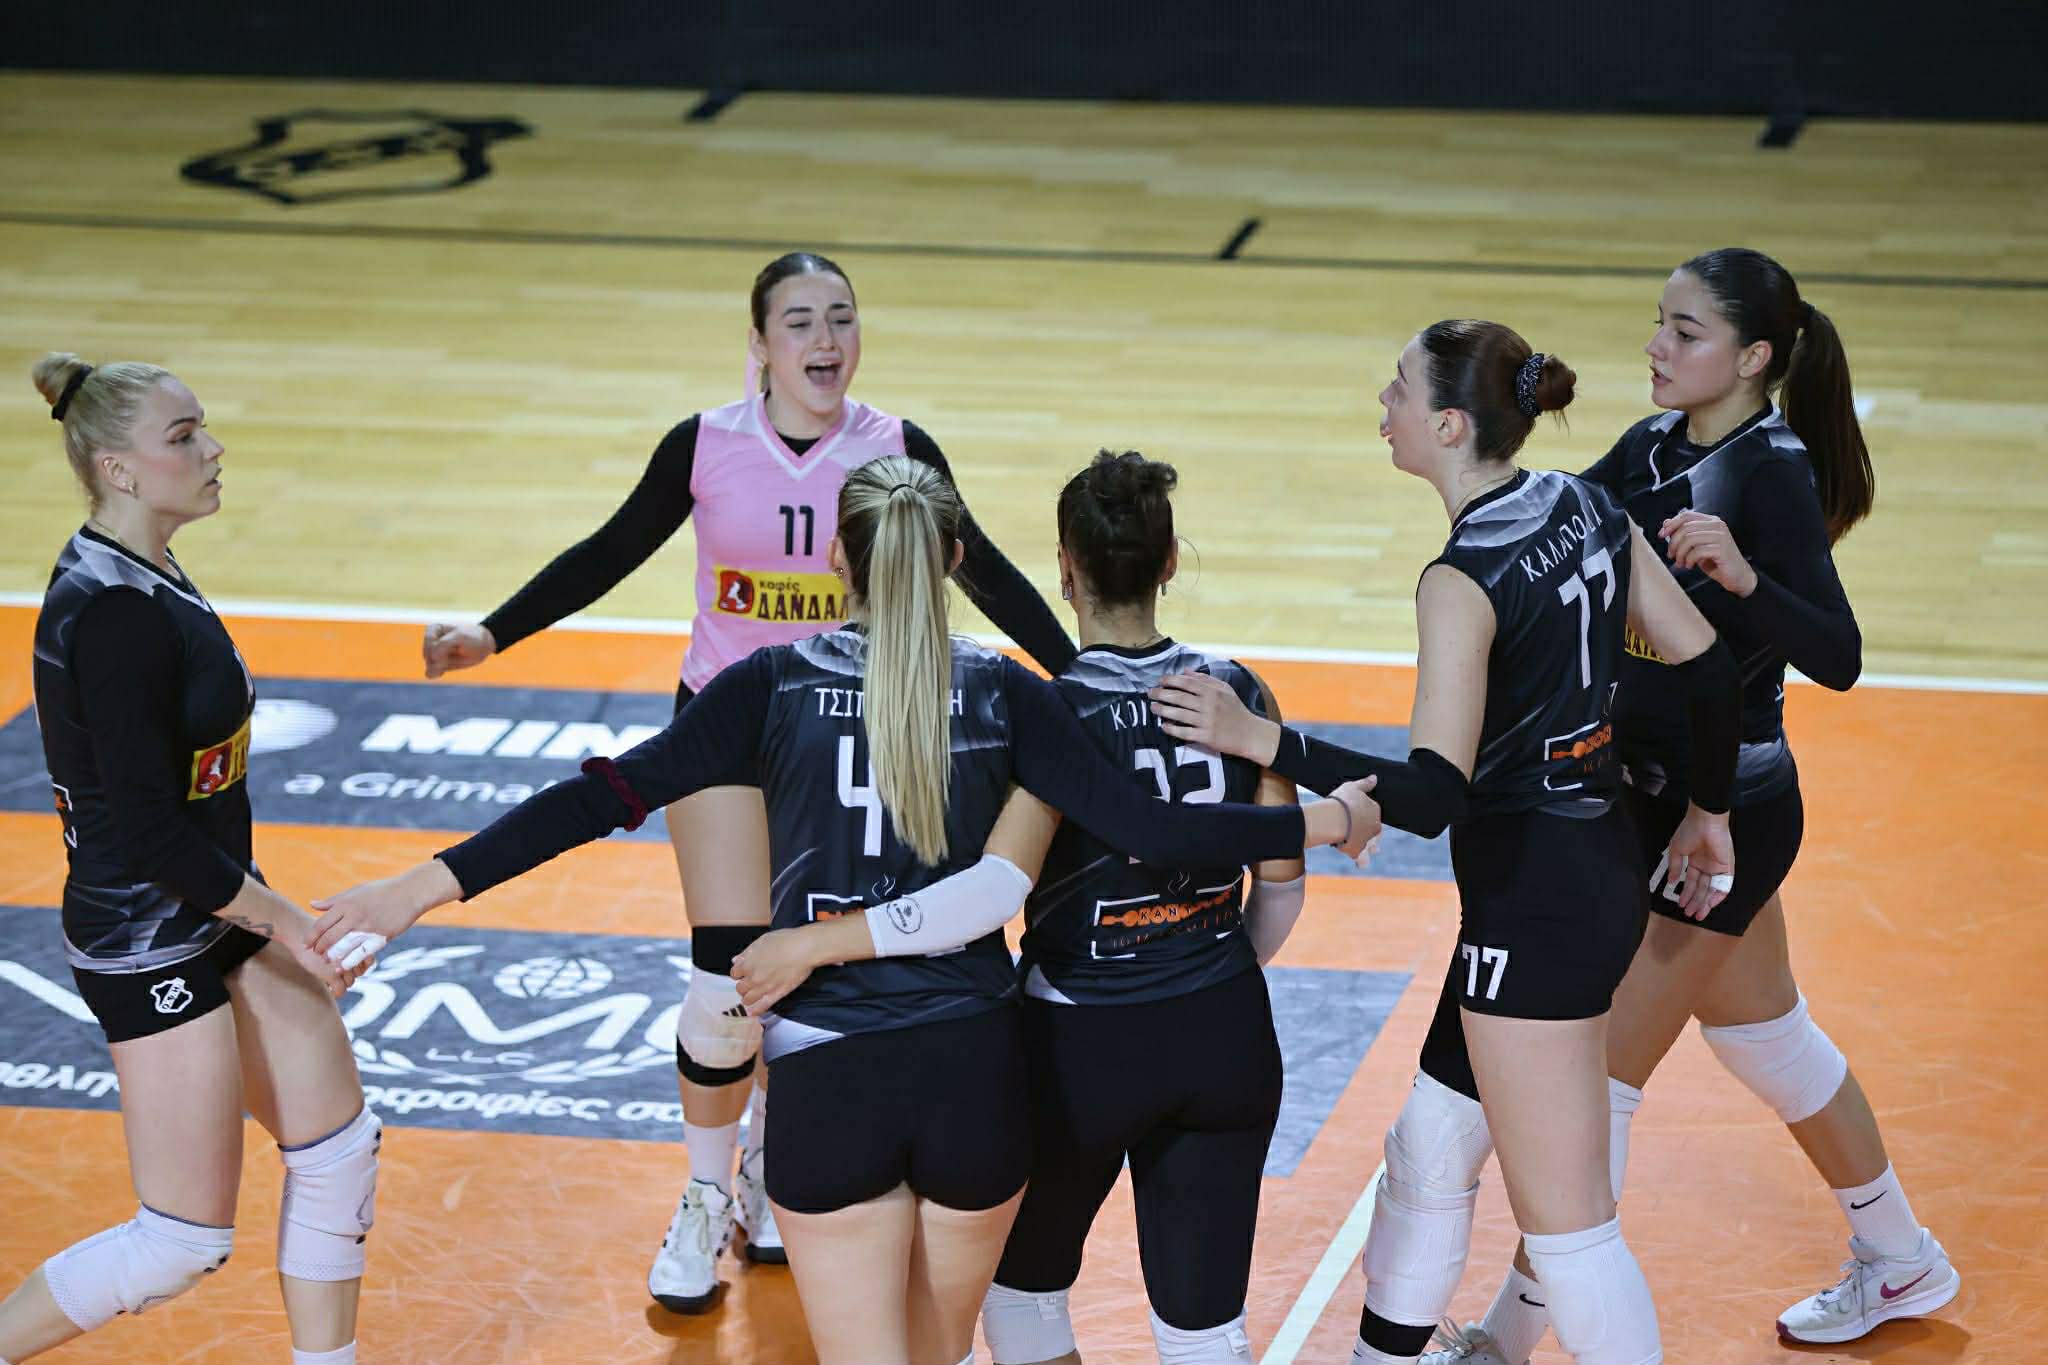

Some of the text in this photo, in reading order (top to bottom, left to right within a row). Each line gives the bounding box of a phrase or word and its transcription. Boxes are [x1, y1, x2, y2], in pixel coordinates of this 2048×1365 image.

[780, 505, 814, 556] 11
[360, 713, 664, 759] MIN
[284, 772, 548, 804] a Grima
[838, 735, 883, 857] 4
[425, 1047, 535, 1066] LLC
